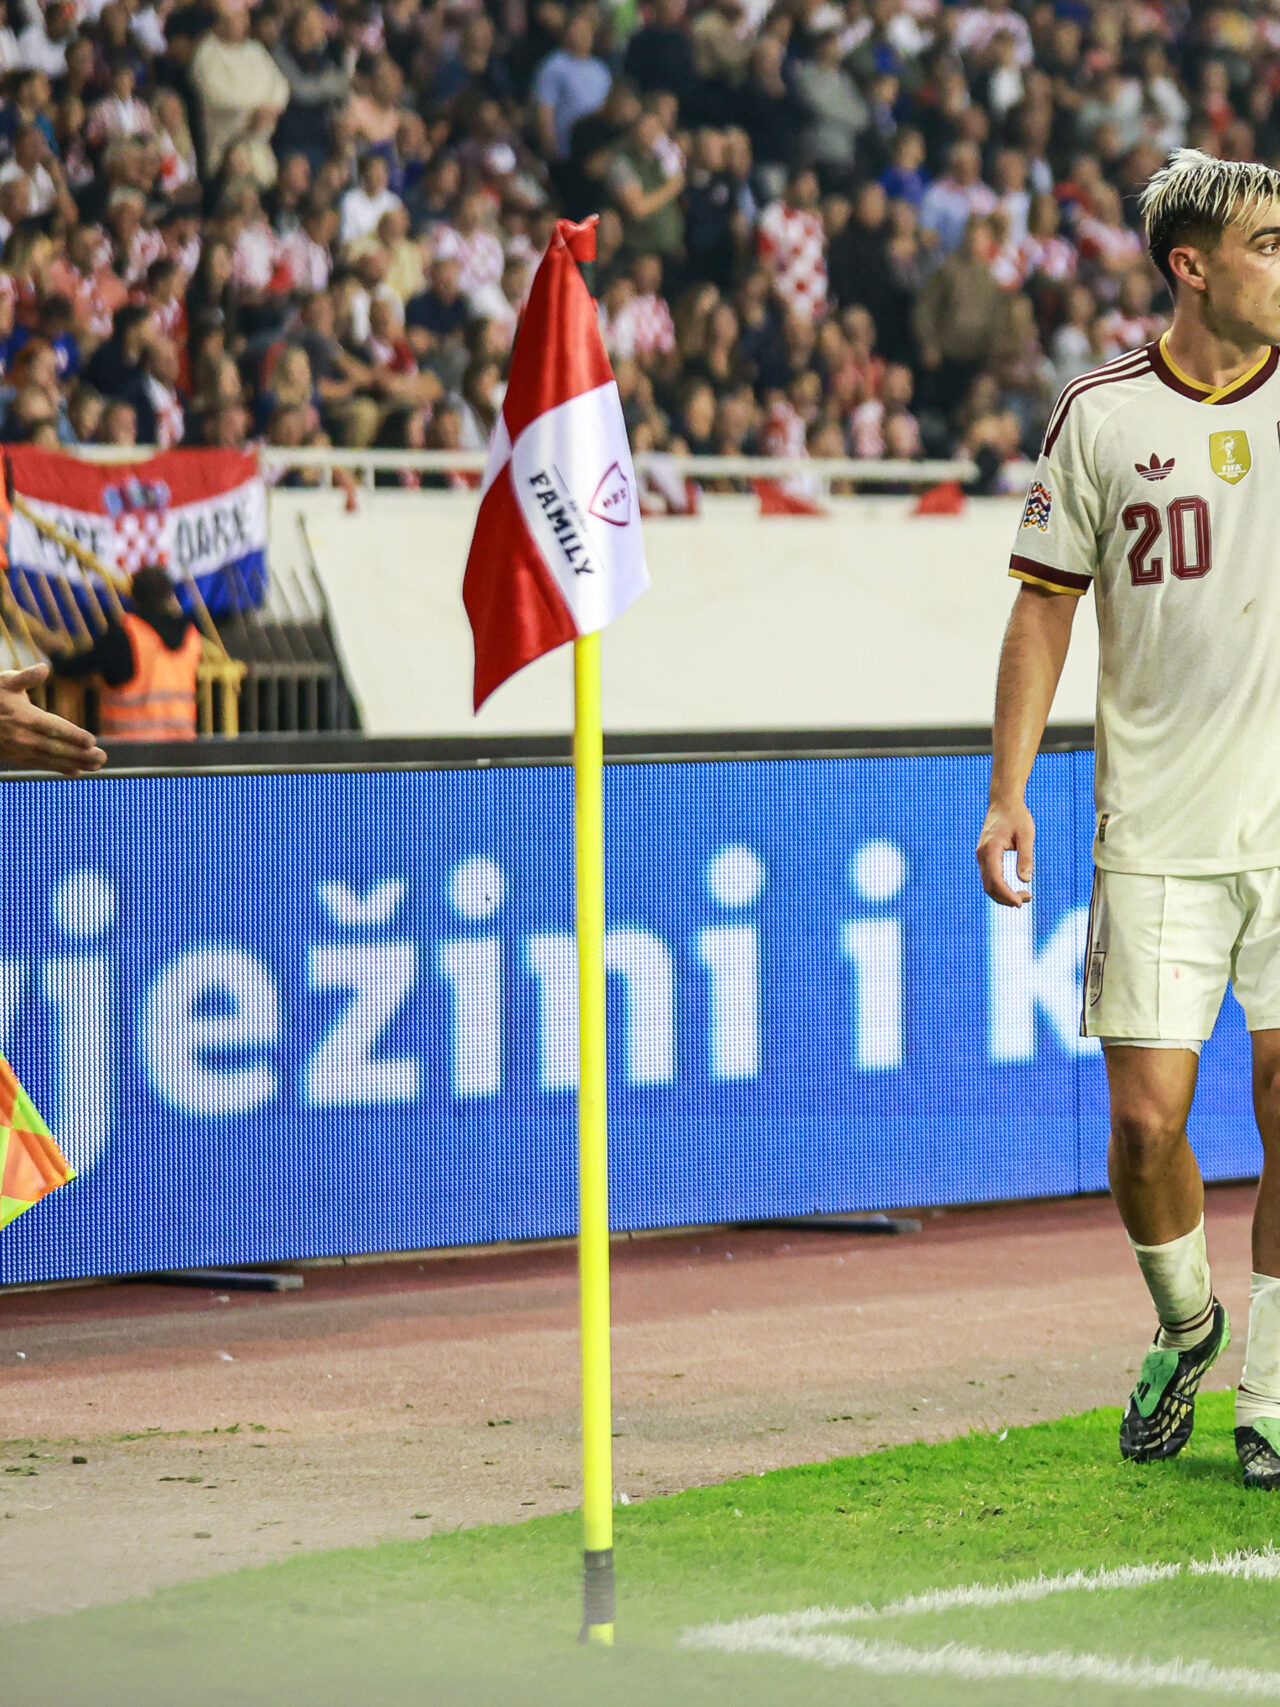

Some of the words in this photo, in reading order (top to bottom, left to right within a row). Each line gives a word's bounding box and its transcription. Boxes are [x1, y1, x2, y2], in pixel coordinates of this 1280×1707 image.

[529, 469, 594, 576] FAMILY
[1122, 494, 1213, 587] 20
[0, 843, 768, 1178] ježini
[840, 839, 909, 1073] i
